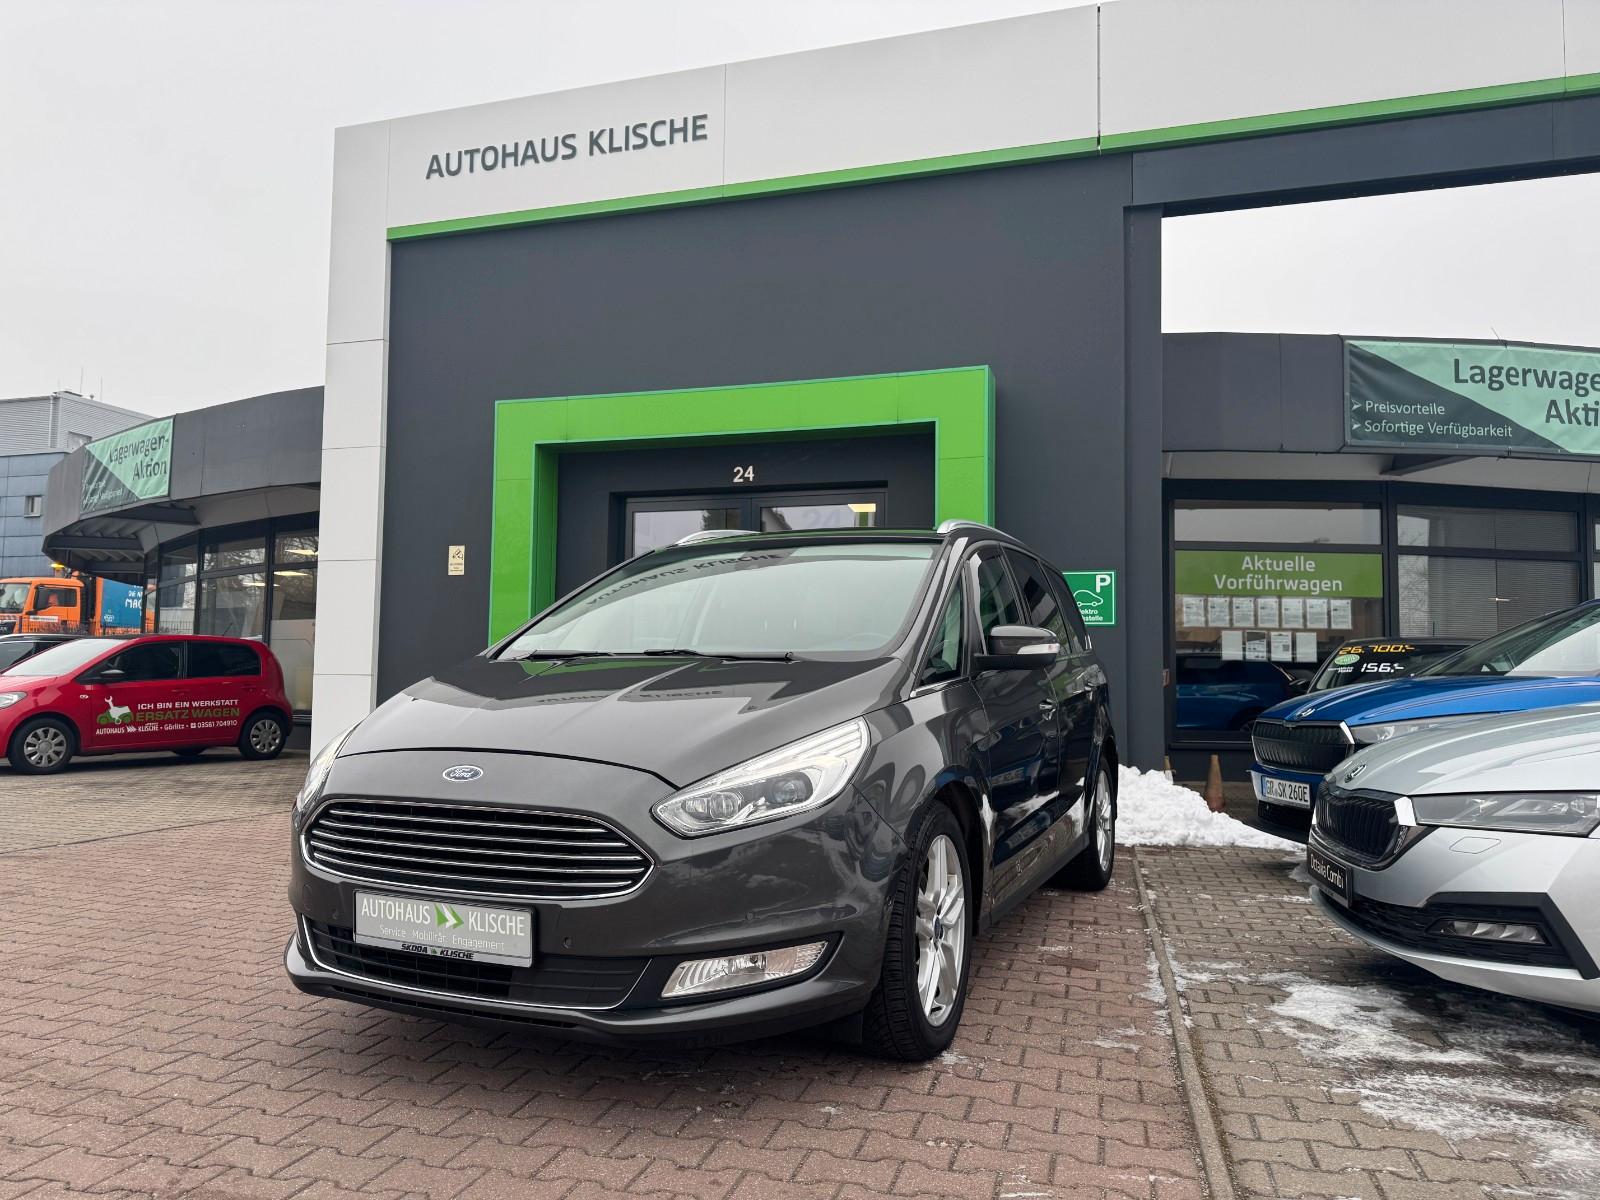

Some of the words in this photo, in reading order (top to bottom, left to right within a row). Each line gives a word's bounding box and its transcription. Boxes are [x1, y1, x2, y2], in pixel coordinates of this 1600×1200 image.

[426, 134, 576, 179] AUTOHAUS
[589, 114, 708, 156] KLISCHE
[1365, 400, 1445, 415] Preisvorteile
[1364, 420, 1424, 436] Sofortige
[1427, 421, 1513, 438] Verfügbarkeit
[109, 434, 168, 464] Lagerwagen-
[133, 458, 167, 480] Aktion
[733, 465, 755, 483] 24
[1241, 555, 1316, 572] Aktuelle
[1095, 574, 1111, 593] P
[1213, 573, 1343, 595] Vorführwagen
[192, 699, 239, 707] WERKSTATT
[135, 710, 189, 722] ERSATZ
[191, 707, 240, 719] WAGEN
[96, 726, 125, 735] AUTOHAUS
[164, 722, 185, 731] Görlitz
[1278, 782, 1287, 799] SK
[1289, 784, 1309, 803] 260E
[1310, 853, 1326, 878] Octavia
[1326, 864, 1344, 889] Combi
[361, 898, 431, 925] AUTOHAUS
[468, 911, 526, 937] KLISCHE
[379, 924, 407, 938] Service
[452, 934, 505, 951] Engagement
[440, 949, 474, 960] KLISCHE
